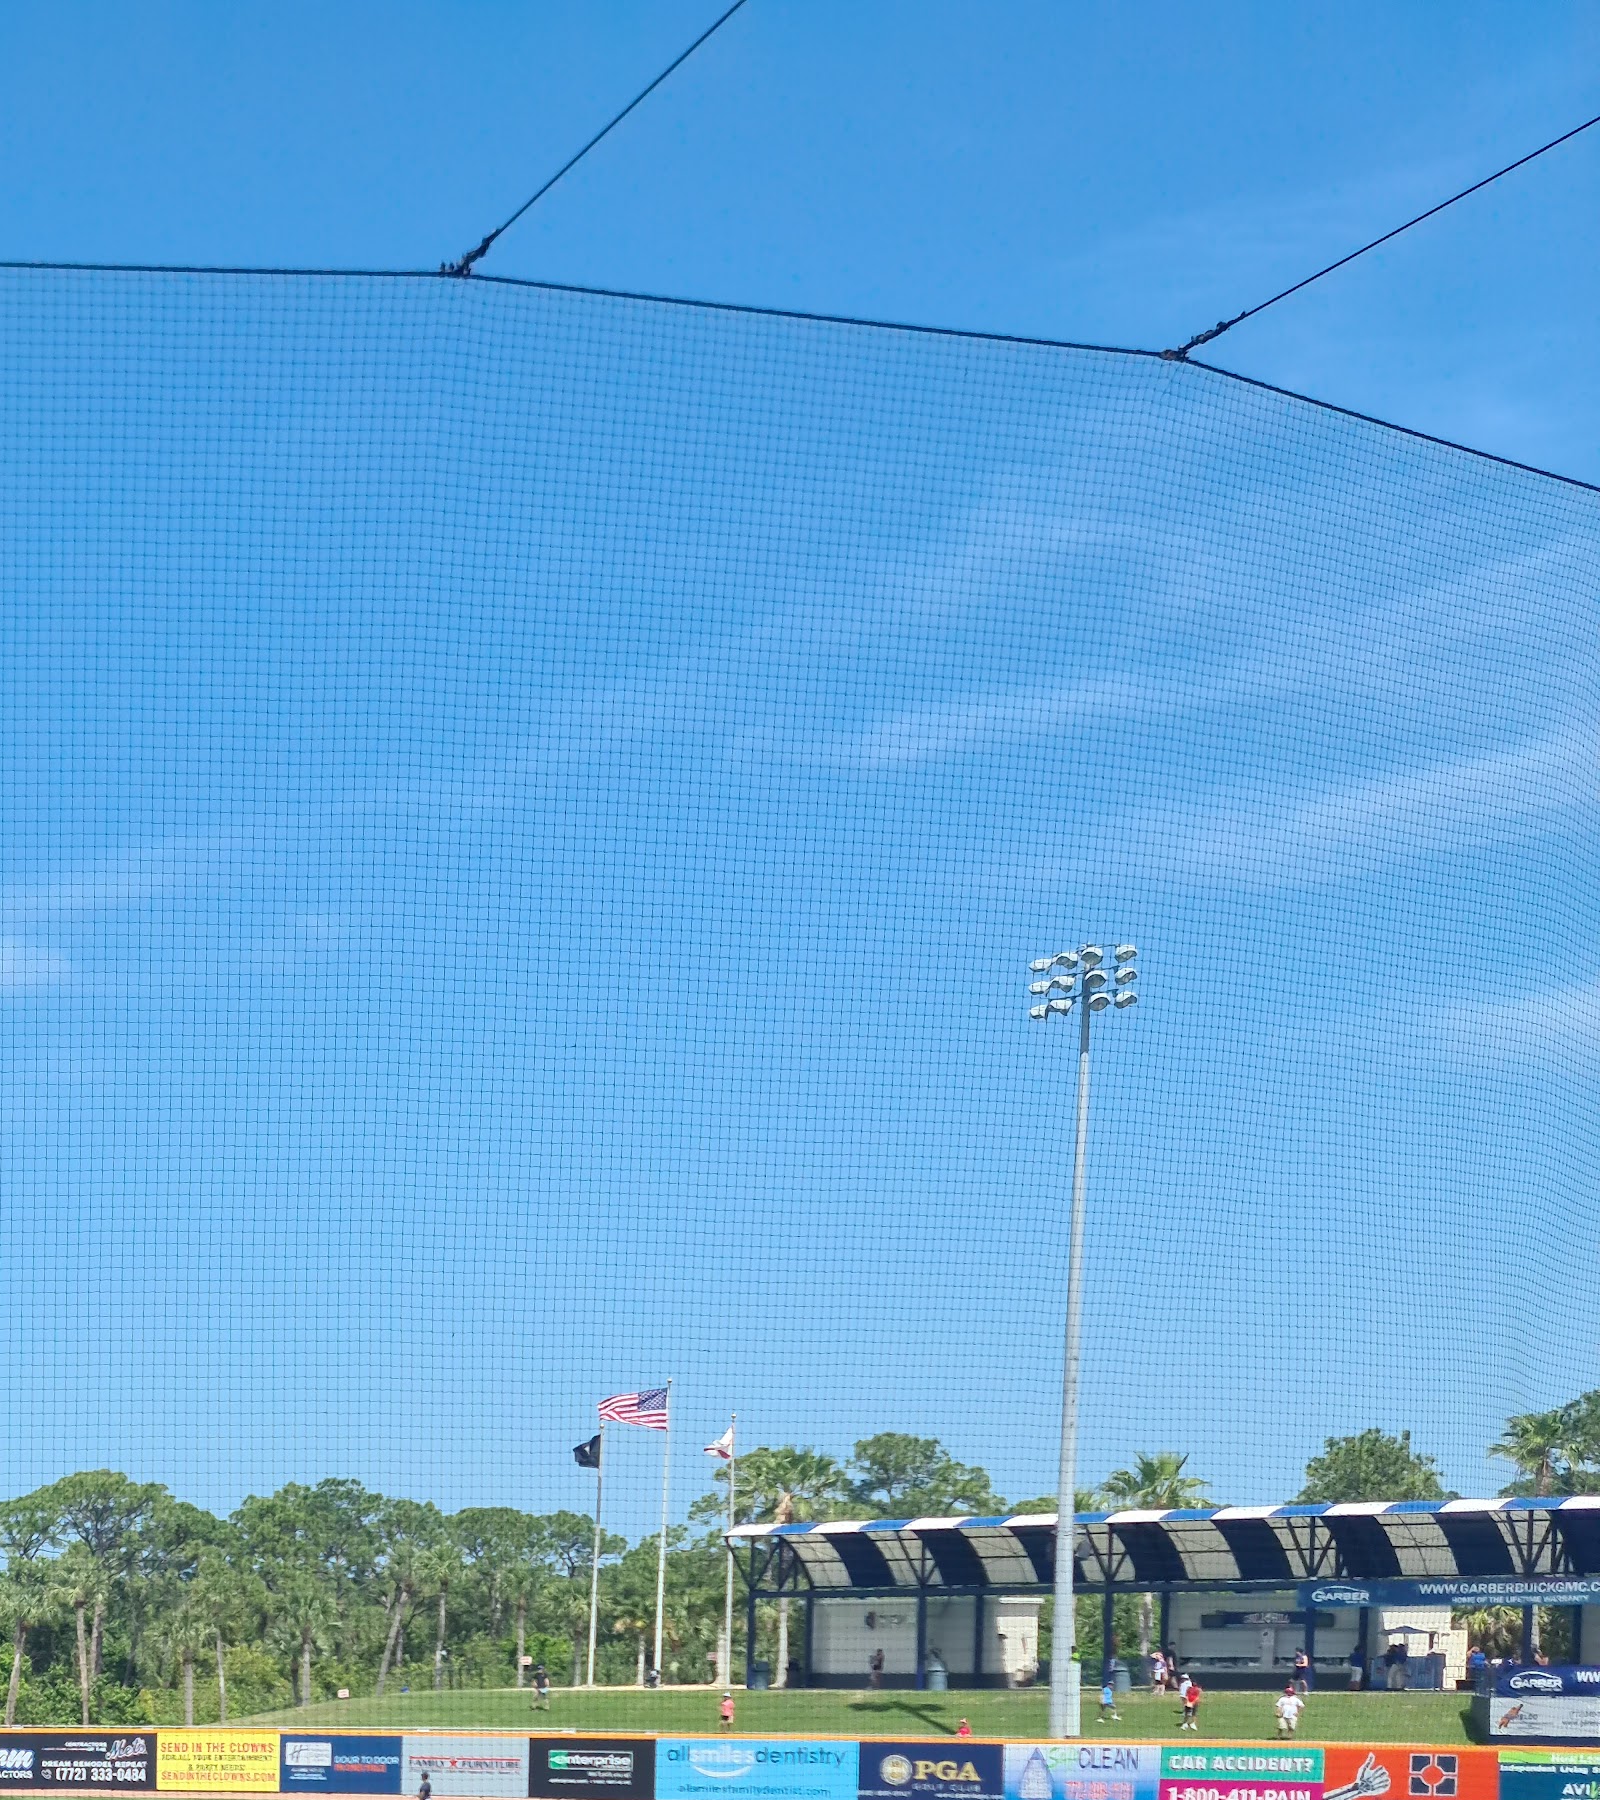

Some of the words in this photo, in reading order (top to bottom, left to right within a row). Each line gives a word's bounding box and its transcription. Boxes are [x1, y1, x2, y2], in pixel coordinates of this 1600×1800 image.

[1311, 1590, 1370, 1603] GARBER
[1509, 1676, 1563, 1689] GARBER
[105, 1737, 147, 1760] Mets
[161, 1743, 188, 1753] SEND
[191, 1743, 202, 1753] IN
[206, 1743, 225, 1753] THE
[230, 1743, 275, 1754] CLOWNS
[409, 1759, 445, 1768] FAMILY
[462, 1760, 520, 1769] FURNITURE
[550, 1754, 631, 1769] enterprise
[1170, 1755, 1206, 1771] CAR
[1212, 1756, 1314, 1773] ACCIDENT?
[56, 1768, 86, 1781] (772)
[912, 1760, 981, 1781] PGA
[1500, 1764, 1556, 1773] Independent
[1560, 1765, 1588, 1775] Living
